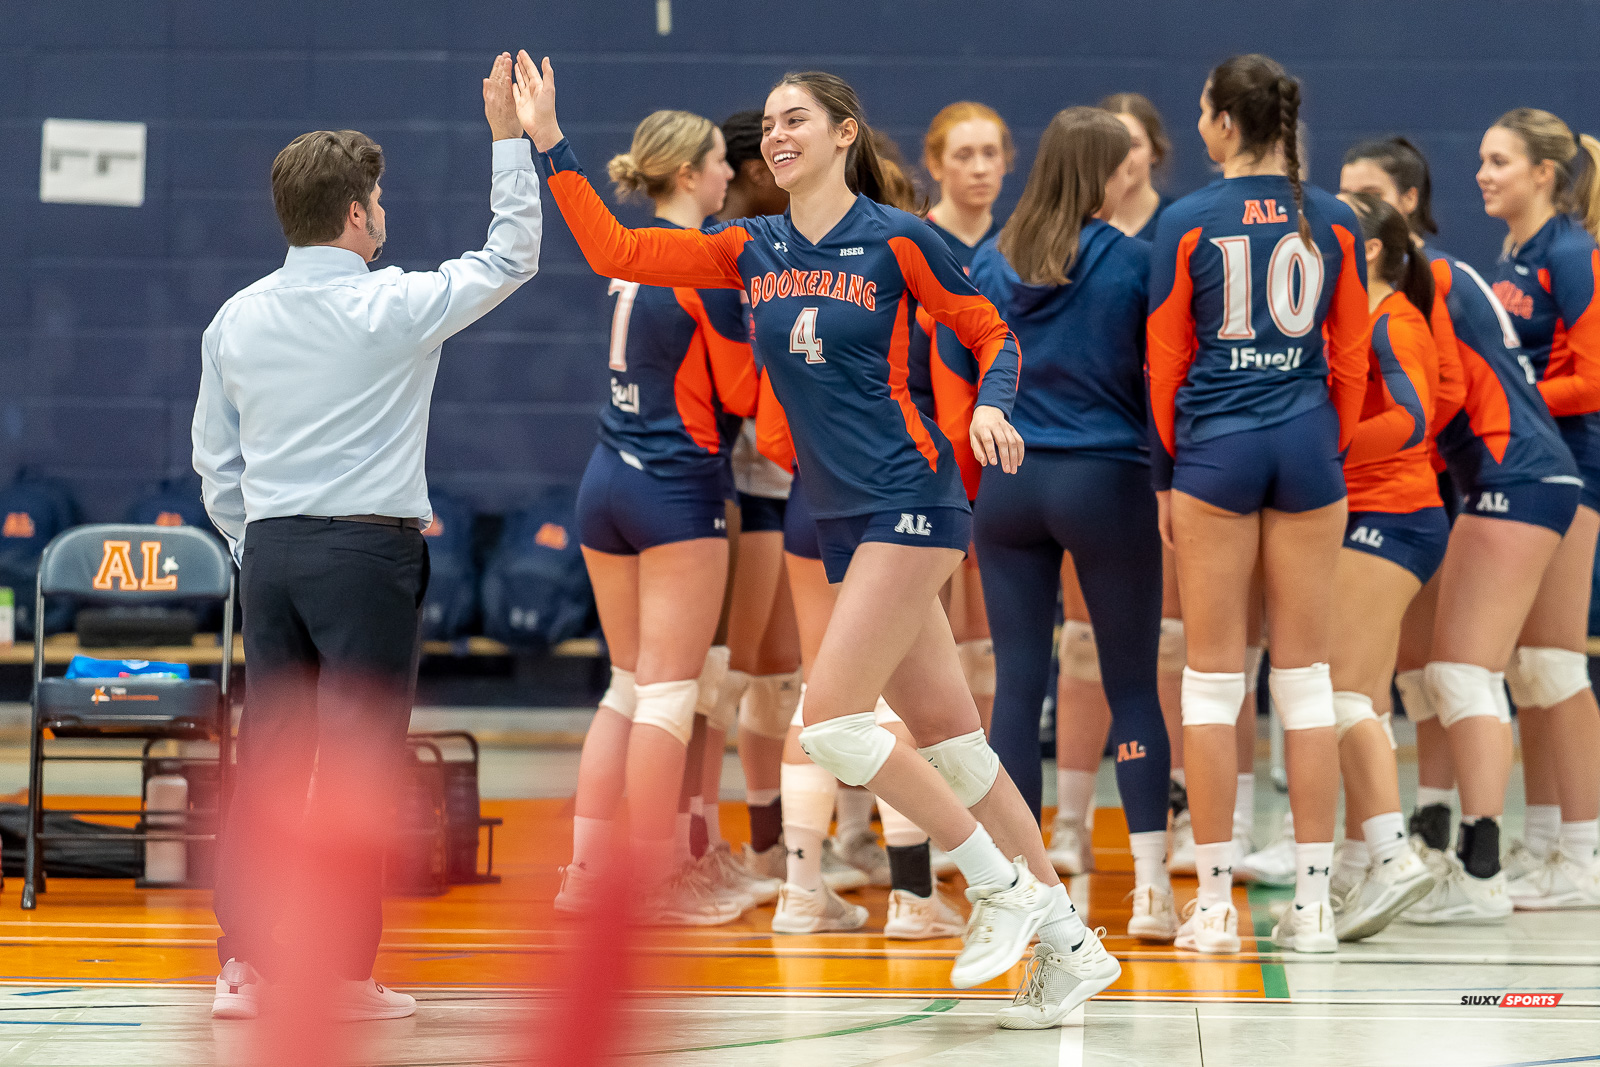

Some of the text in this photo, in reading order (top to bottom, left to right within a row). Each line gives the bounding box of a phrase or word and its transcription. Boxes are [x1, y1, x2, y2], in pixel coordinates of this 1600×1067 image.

[1242, 199, 1288, 225] AL
[750, 267, 877, 311] BOOMERANG
[1209, 231, 1325, 340] 10
[789, 306, 827, 364] 4
[894, 512, 932, 536] AL
[92, 540, 179, 591] AL
[1117, 740, 1147, 763] AL
